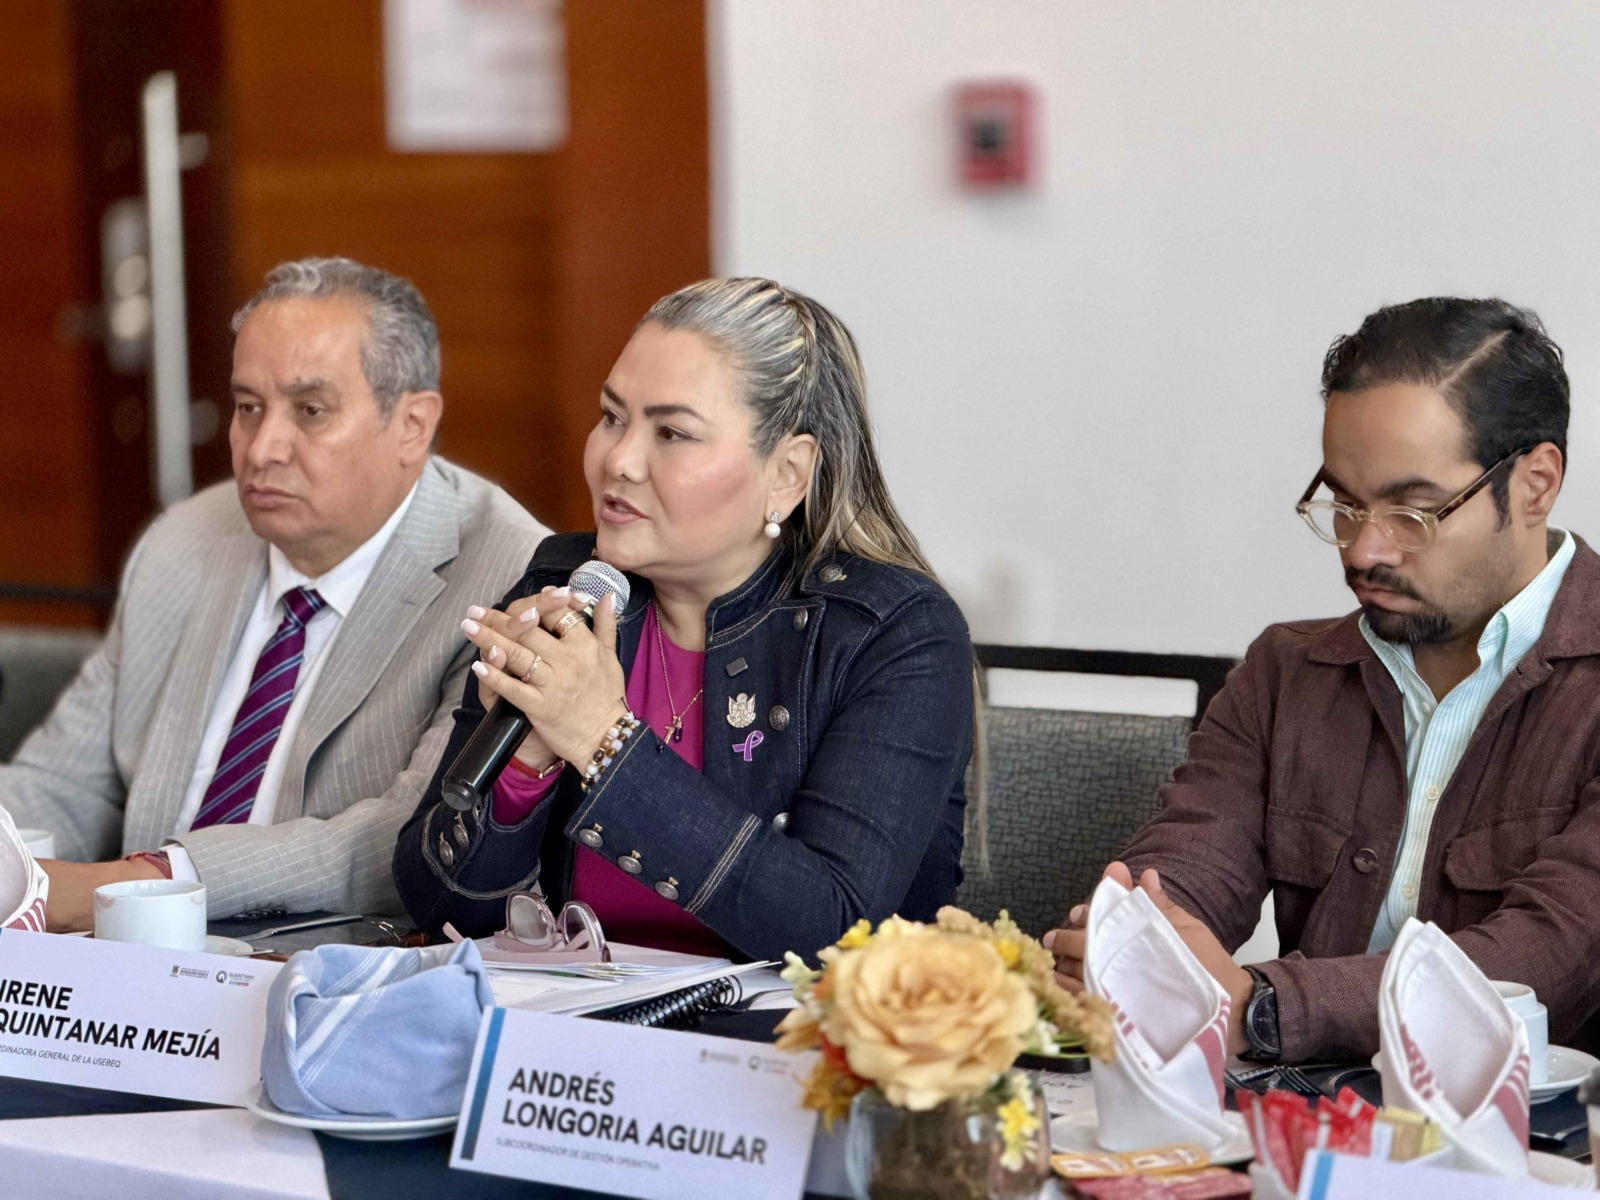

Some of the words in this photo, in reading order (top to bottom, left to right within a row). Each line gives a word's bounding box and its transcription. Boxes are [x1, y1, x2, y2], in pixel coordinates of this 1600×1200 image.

[0, 979, 73, 1010] IRENE
[0, 1044, 37, 1056] DINADORA
[38, 1049, 70, 1062] GENERAL
[71, 1054, 82, 1063] DE
[82, 1056, 91, 1064] LA
[93, 1058, 121, 1068] USEBEQ
[142, 1029, 219, 1060] MEJÍA
[508, 1068, 615, 1105] ANDRÉS
[502, 1099, 640, 1144] LONGORIA
[647, 1122, 768, 1164] AGUILAR
[496, 1137, 568, 1156] SUBCOORDINADOR
[568, 1149, 580, 1158] DE
[581, 1150, 615, 1164] GESTIÓN
